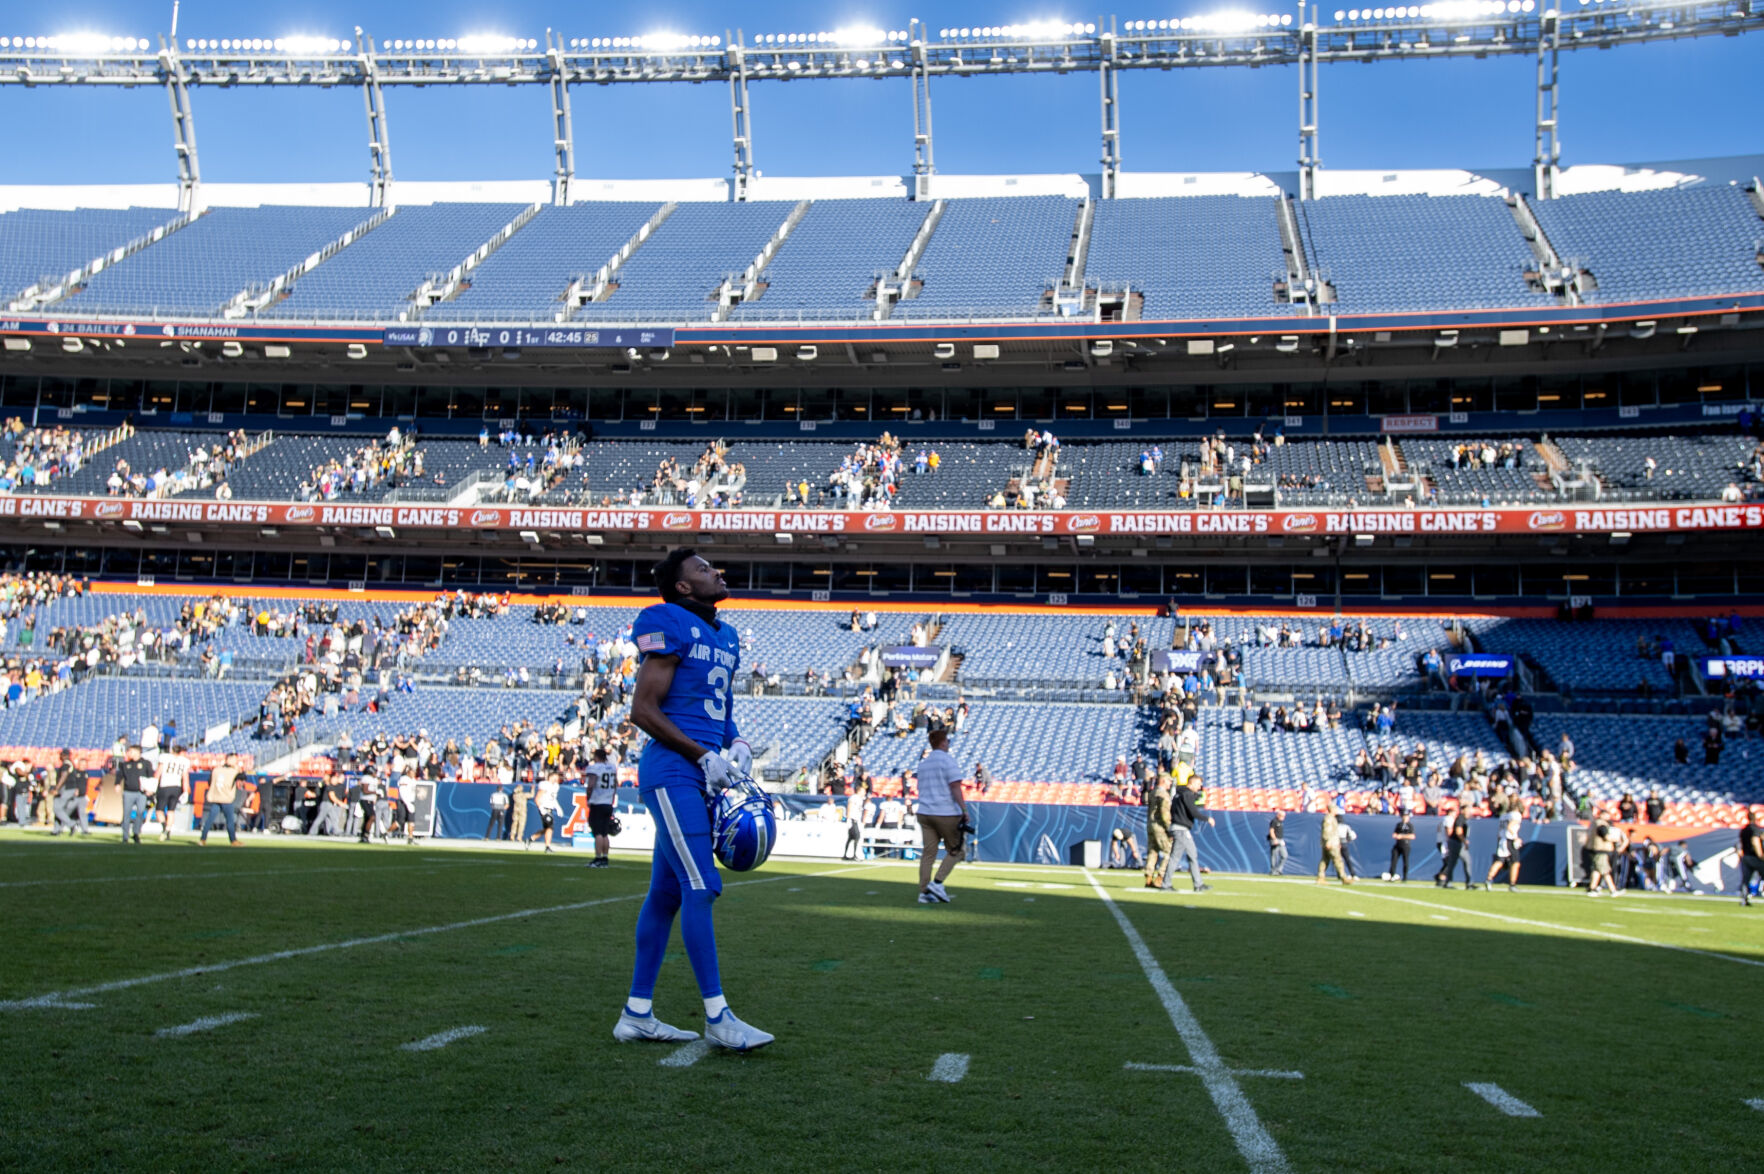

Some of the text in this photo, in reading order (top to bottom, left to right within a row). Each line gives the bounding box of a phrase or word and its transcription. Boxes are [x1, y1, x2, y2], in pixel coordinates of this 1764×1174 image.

[0, 321, 20, 331] AM
[78, 324, 120, 334] BAILEY
[177, 326, 238, 337] SHANAHAN
[447, 331, 458, 344] 0
[500, 331, 510, 344] 0
[547, 331, 582, 343] 42:45
[20, 500, 83, 517] CANE'S
[131, 503, 268, 521] RAISING CANE'S
[322, 507, 460, 525] RAISING CANE'S
[509, 511, 650, 528] RAISING CANE'S
[700, 513, 845, 531] RAISING CANE'S
[904, 514, 1055, 532] RAISING CANE'S
[1110, 514, 1268, 532] RAISING CANE'S
[1326, 513, 1497, 532] RAISING CANE'S
[1575, 506, 1763, 530] RAISING CANE'S
[813, 591, 828, 600] 124
[1051, 594, 1066, 604] 125
[1299, 595, 1315, 605] 126
[688, 643, 710, 661] AIR
[1463, 660, 1508, 668] BOEING
[704, 665, 729, 721] 3
